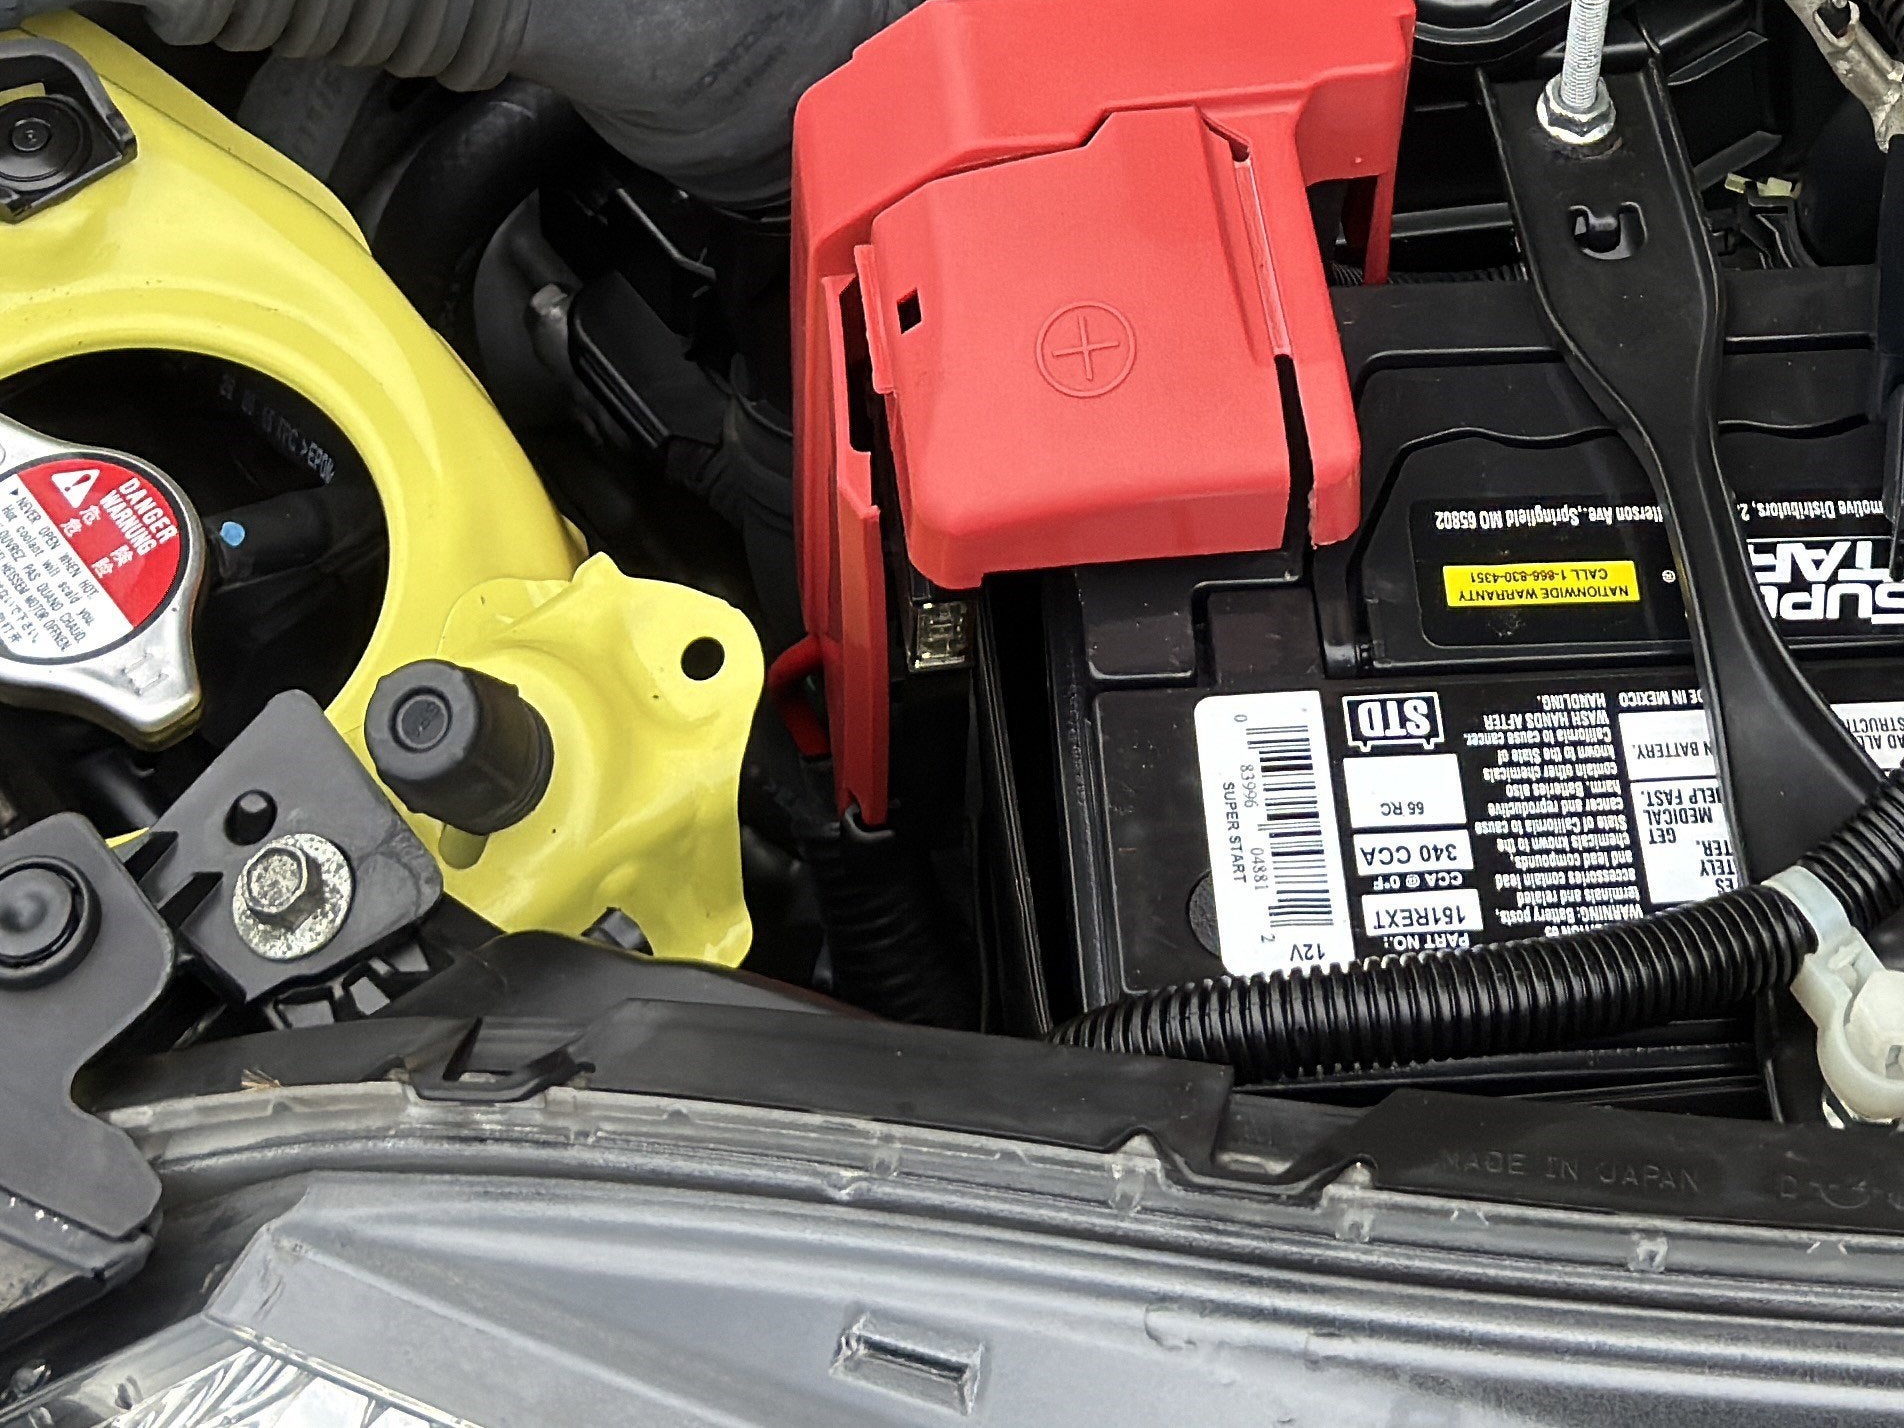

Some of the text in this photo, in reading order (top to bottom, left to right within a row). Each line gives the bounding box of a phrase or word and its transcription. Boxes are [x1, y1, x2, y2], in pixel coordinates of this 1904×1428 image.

[77, 502, 104, 527] 危
[118, 476, 179, 544] DANGER
[1838, 500, 1883, 517] motive
[58, 514, 85, 539] 危
[99, 489, 158, 556] WARNUNG
[1435, 510, 1476, 529] 65802
[1480, 510, 1503, 529] MO
[14, 495, 41, 525] NEVER
[37, 525, 60, 550] OPEN
[57, 551, 82, 578] WHEN
[21, 563, 40, 582] PAS
[40, 558, 60, 579] will
[56, 579, 80, 605] scald
[1470, 568, 1608, 583] CALL 1-866-830-4351
[1458, 585, 1629, 602] NATIONWIDE WARRANTY
[23, 593, 48, 621] MOTOR
[1536, 692, 1607, 710] HANDLING.
[1618, 690, 1669, 707] MEXICO
[1671, 689, 1688, 706] IN
[1357, 699, 1431, 738] STD
[1483, 709, 1610, 730] WASH HANDS AFTER
[1463, 727, 1612, 746] California to cause cancer.
[1497, 744, 1616, 765] known to the State of
[1631, 742, 1699, 760] BATTERY.
[1482, 762, 1617, 782] contain other chemicals
[1506, 779, 1621, 799] harm. Batteries also
[1640, 789, 1682, 807] FAST.
[1380, 801, 1403, 816] RC
[1487, 796, 1624, 817] cancer and reproductive
[1643, 806, 1713, 825] MEDICAL
[1223, 782, 1246, 883] SUPER START
[1475, 814, 1627, 836] State of California to cause
[1497, 831, 1631, 854] chemicals known to the
[1648, 827, 1677, 844] GET
[1240, 764, 1258, 808] 83996
[1250, 847, 1268, 891] 04881
[1261, 934, 1275, 944] 2
[1360, 844, 1457, 866] 340 CCA
[1696, 840, 1733, 856] TER.
[1510, 850, 1633, 871] and lead compounds,
[1424, 871, 1463, 886] CCA
[1494, 867, 1636, 891] accessories contain lead
[1516, 886, 1640, 907] terminals and related
[1495, 904, 1643, 925] WARNING: Battery posts,
[1424, 932, 1469, 948] PART
[1290, 944, 1325, 962] 12V
[1544, 1155, 1579, 1181] IN
[1598, 1162, 1699, 1193] JAPAN
